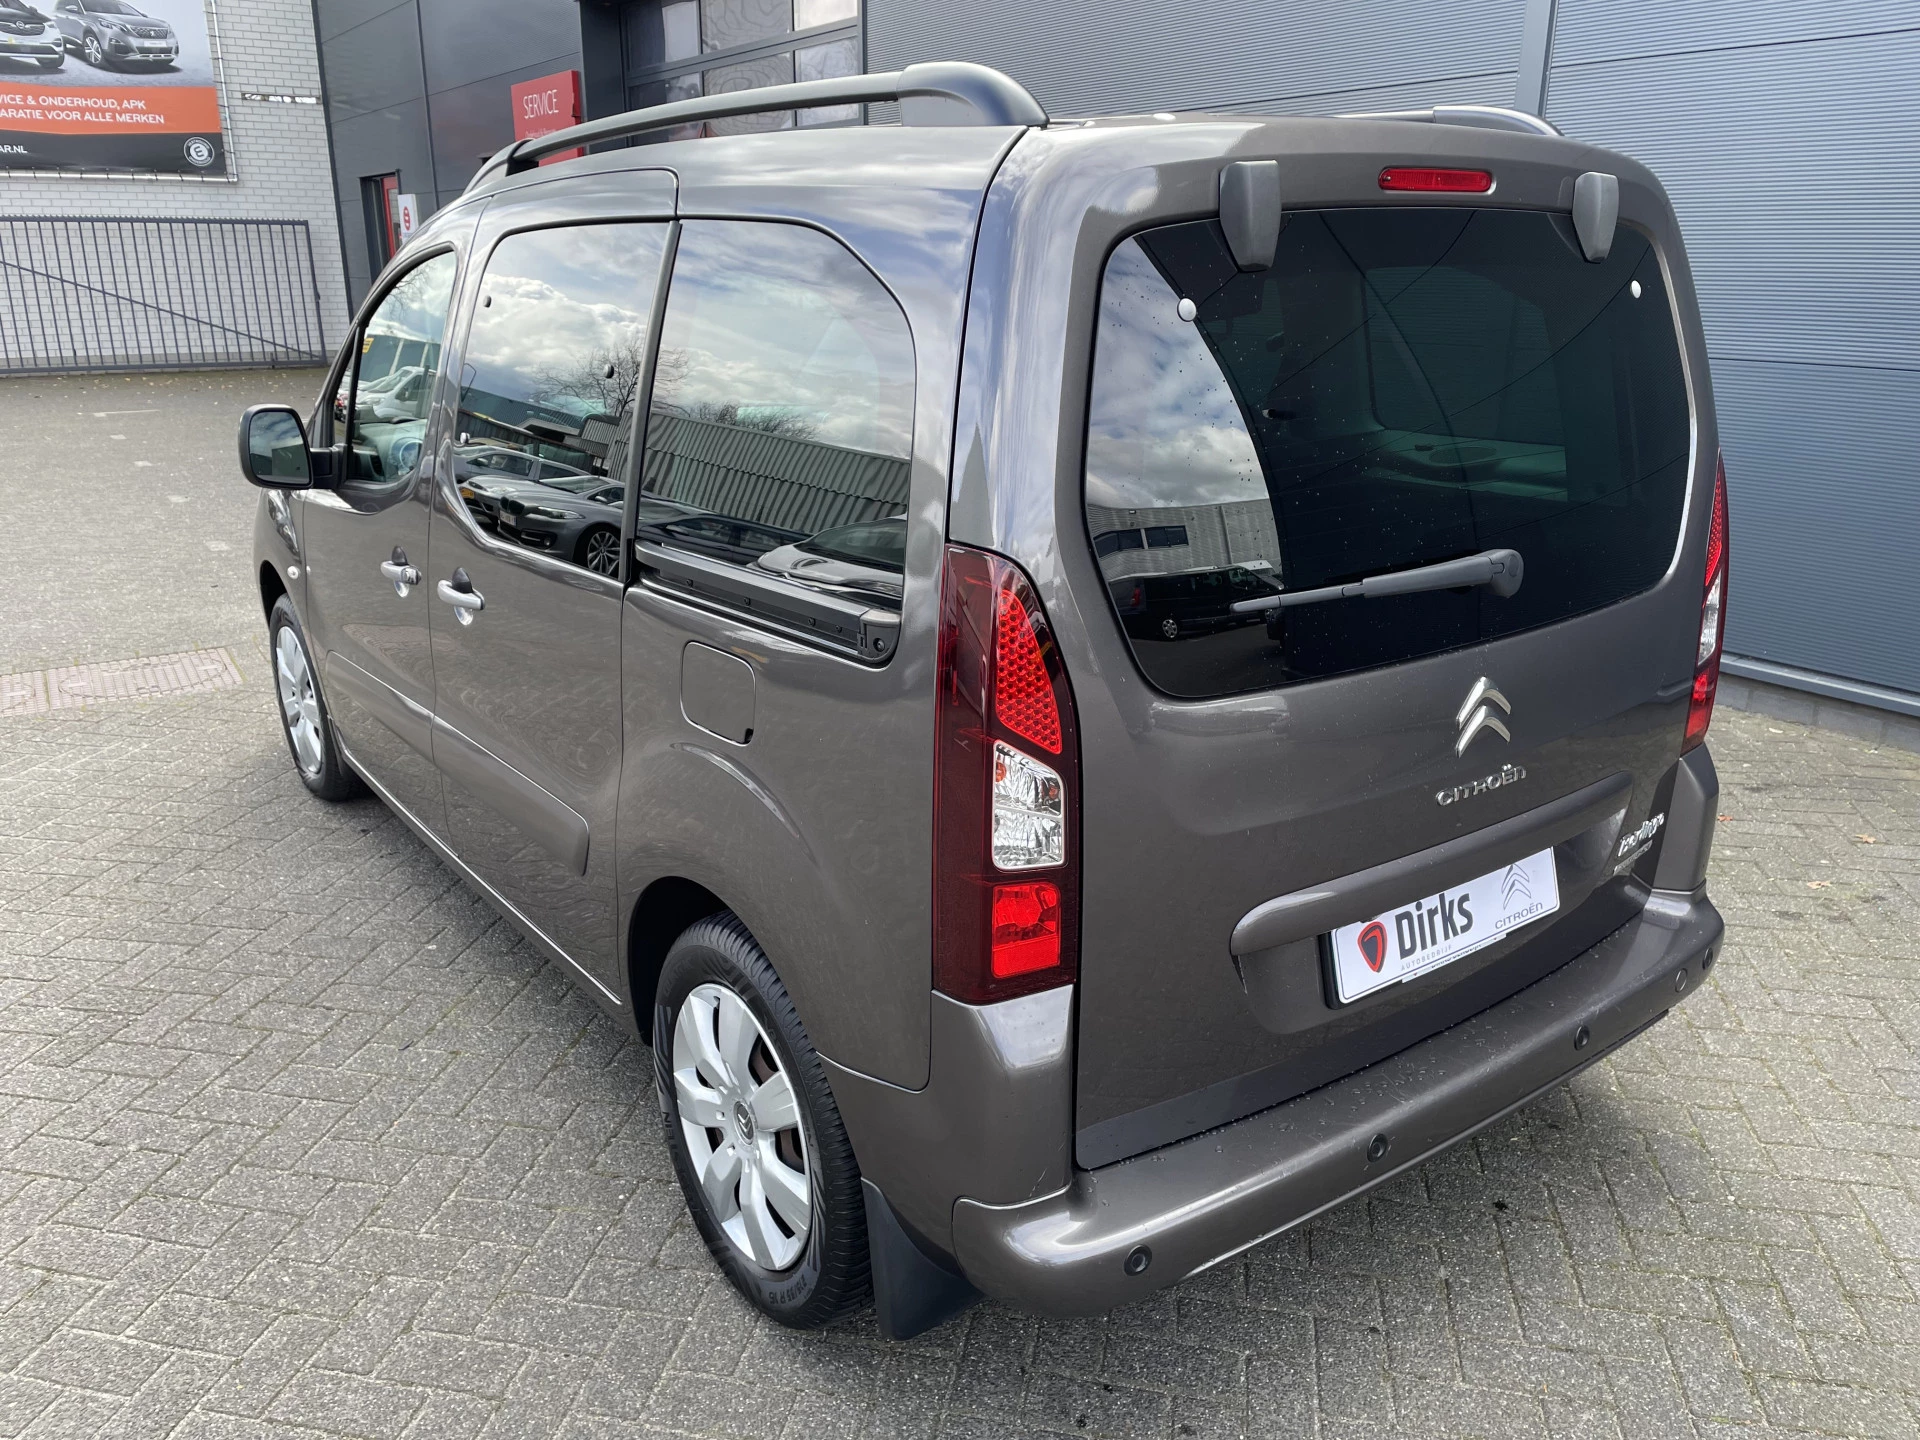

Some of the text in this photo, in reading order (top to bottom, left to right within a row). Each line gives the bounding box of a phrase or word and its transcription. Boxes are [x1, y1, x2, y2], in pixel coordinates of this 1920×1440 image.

[26, 95, 36, 105] &
[38, 95, 120, 110] ONDERHOUD,
[122, 99, 146, 110] APK
[523, 89, 559, 119] SERVICE
[45, 110, 82, 121] VOOR
[84, 111, 113, 122] ALLE
[115, 113, 165, 124] MERKEN
[1394, 892, 1474, 961] Dirks
[1401, 944, 1452, 972] AUTOBEDRIJF
